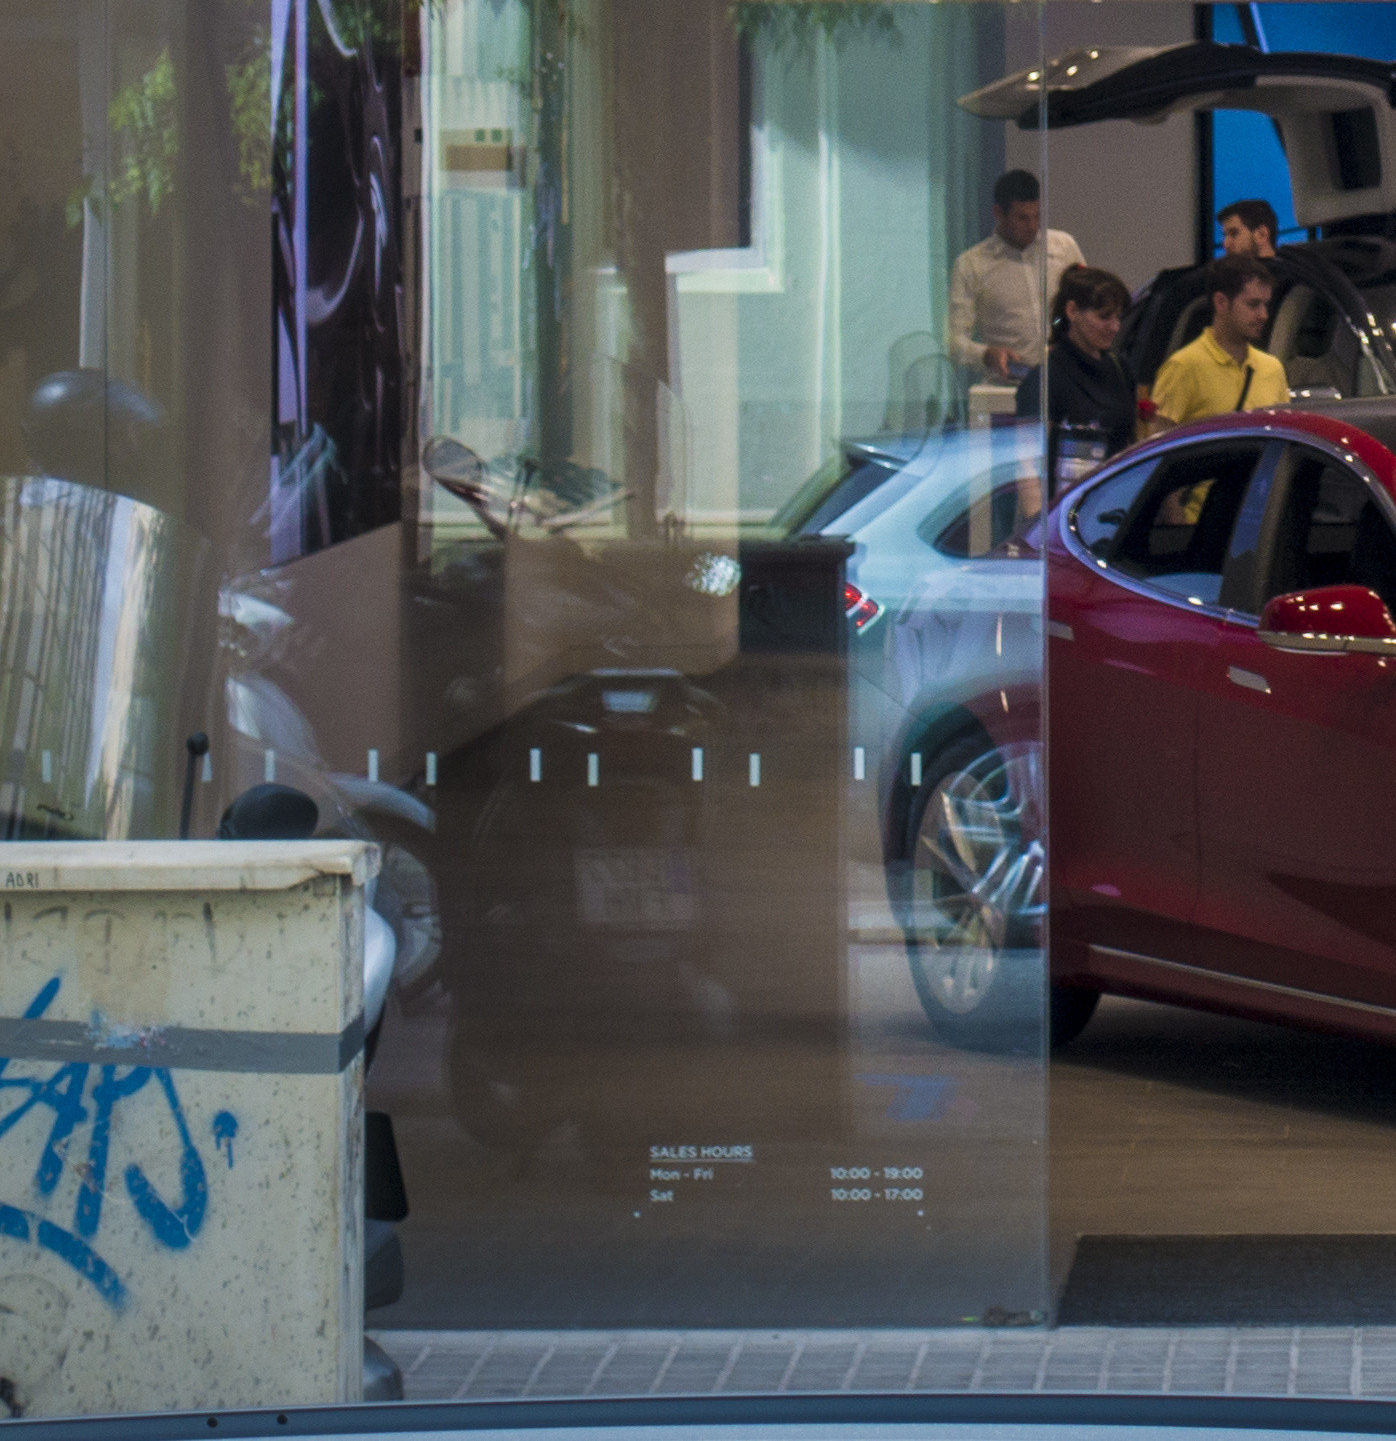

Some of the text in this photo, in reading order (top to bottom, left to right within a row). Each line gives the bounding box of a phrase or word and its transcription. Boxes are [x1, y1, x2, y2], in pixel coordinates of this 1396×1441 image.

[650, 1145, 753, 1159] SALES HOURS
[650, 1168, 680, 1180] Mon
[693, 1167, 714, 1180] Fri
[830, 1167, 870, 1179] 10:00
[883, 1167, 923, 1179] 19:00
[650, 1189, 674, 1202] Sat
[830, 1188, 871, 1201] 10:00
[884, 1188, 923, 1201] 17:00
